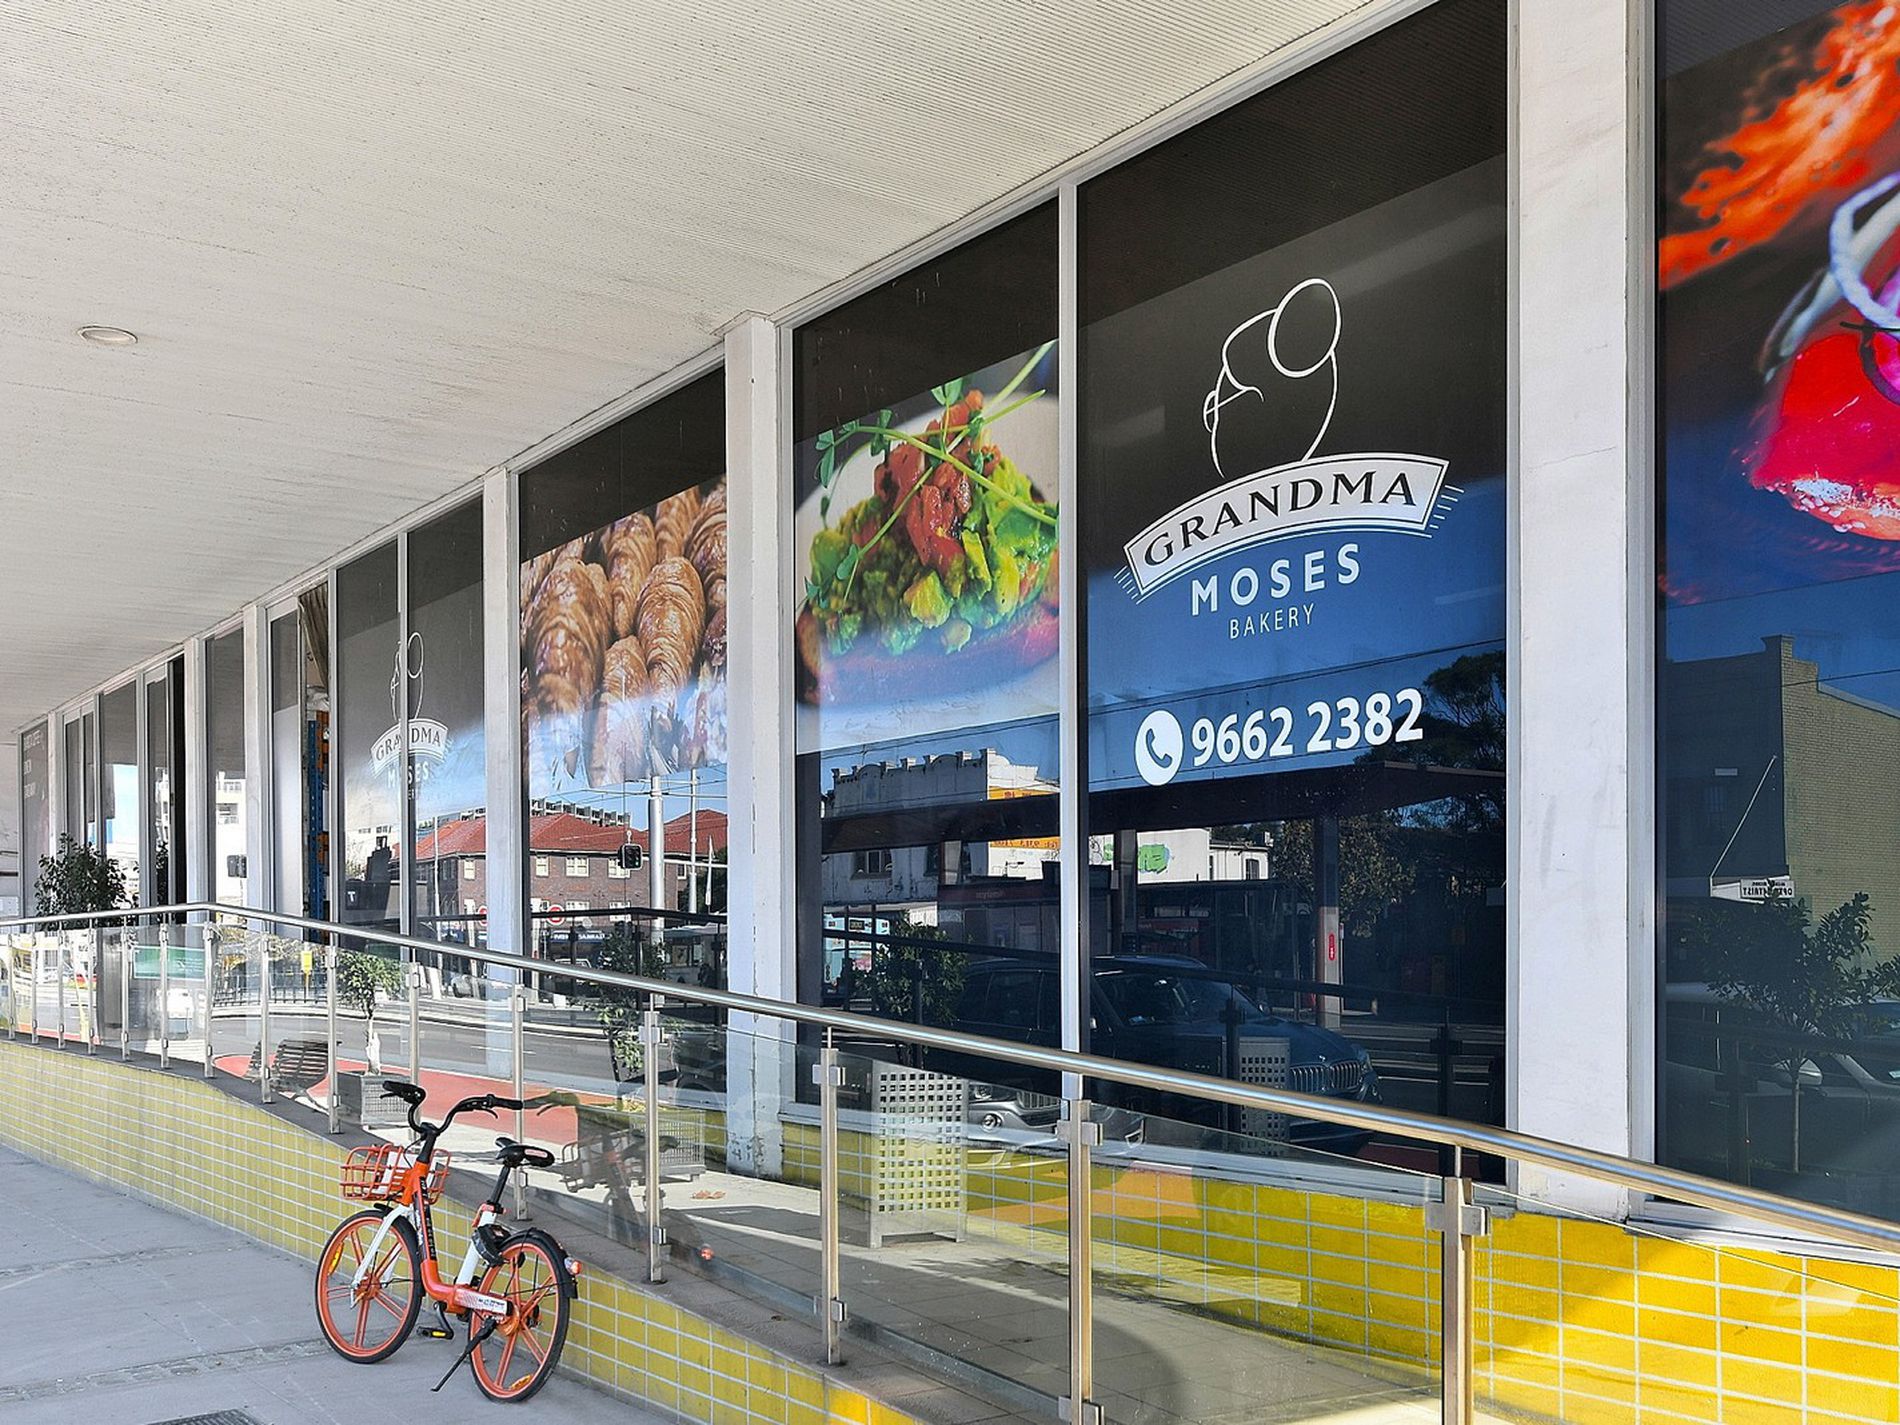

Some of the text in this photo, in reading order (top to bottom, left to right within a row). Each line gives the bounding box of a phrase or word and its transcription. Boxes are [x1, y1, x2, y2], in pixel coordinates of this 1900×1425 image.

[1144, 471, 1417, 567] GRANDMA
[1191, 544, 1360, 616] MOSES
[1229, 603, 1315, 639] BAKERY
[376, 727, 441, 761] GRADMA
[1191, 687, 1424, 767] 9662 2382
[387, 761, 428, 788] MSES
